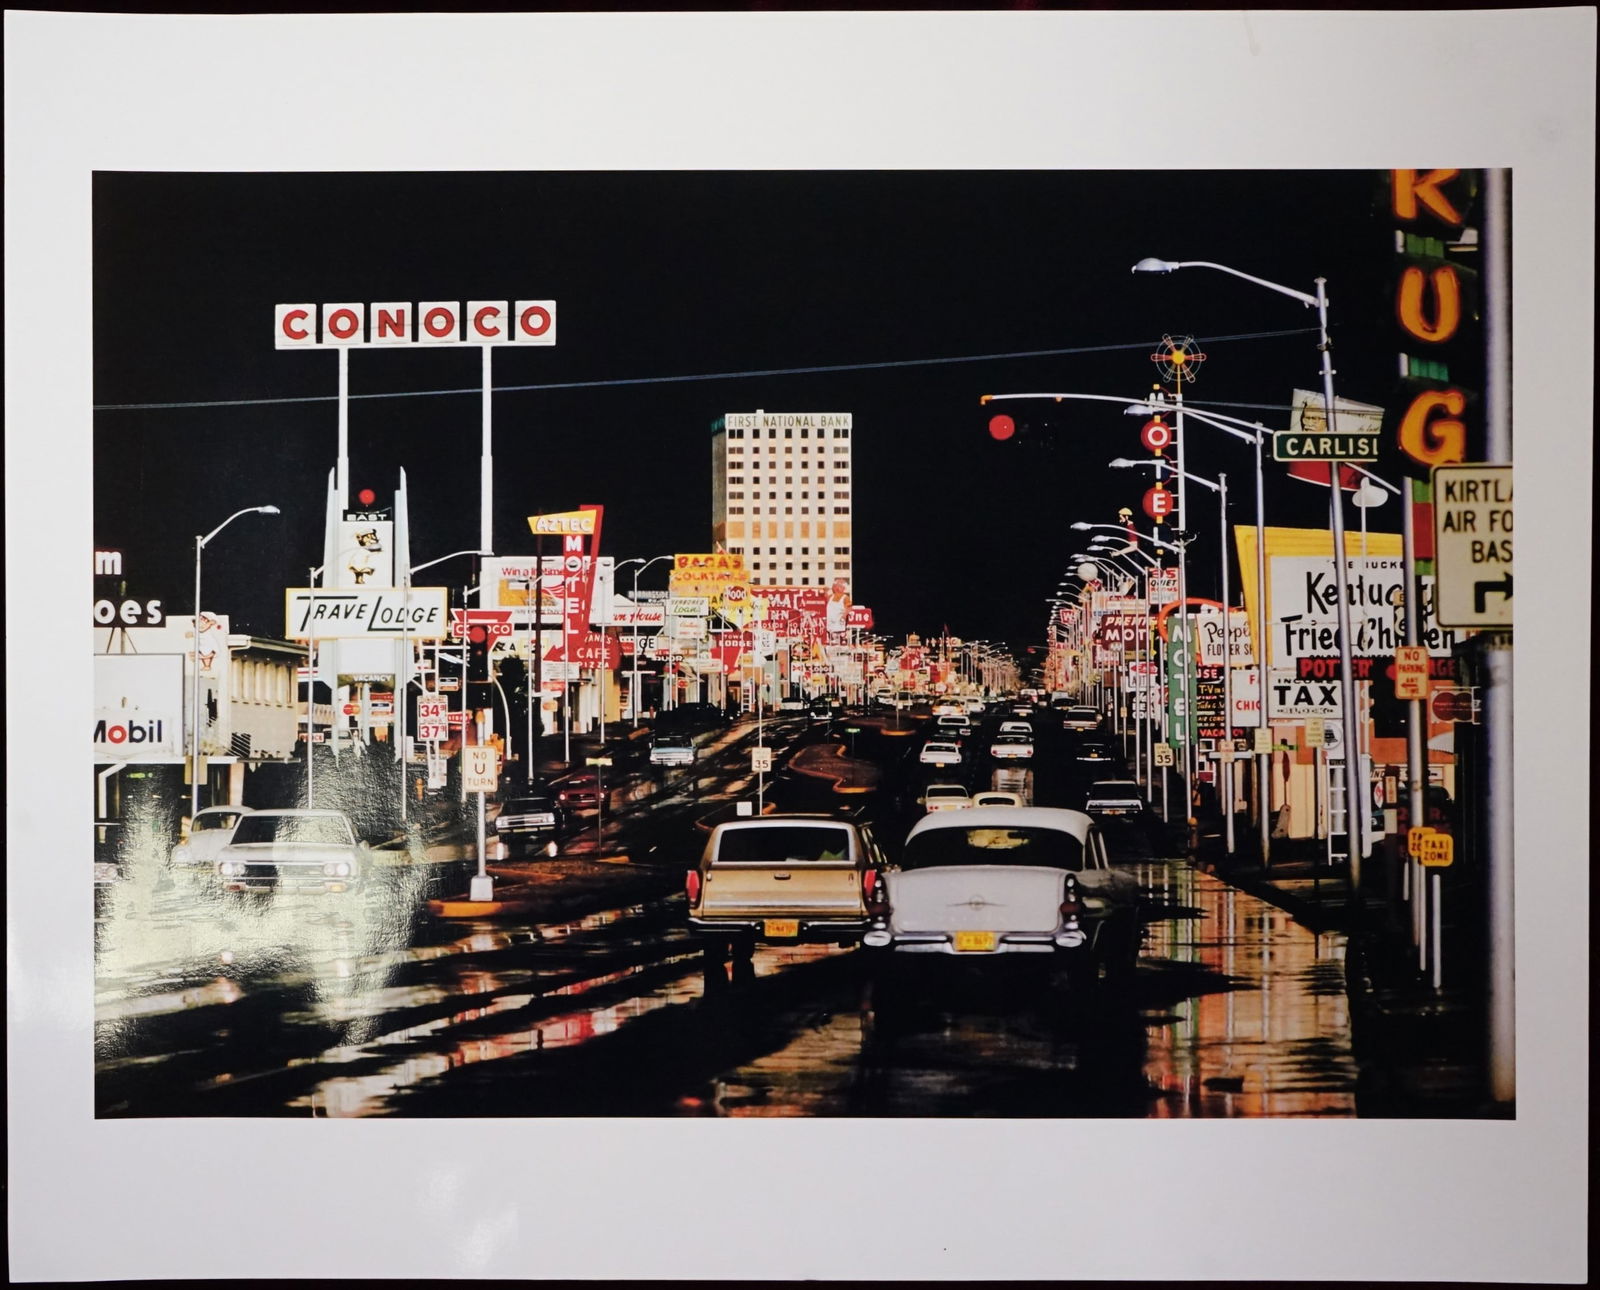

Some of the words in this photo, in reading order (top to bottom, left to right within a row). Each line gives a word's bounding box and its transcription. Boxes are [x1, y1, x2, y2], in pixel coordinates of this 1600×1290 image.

[282, 305, 552, 340] CONOCO
[728, 415, 758, 427] FIRST
[762, 415, 816, 427] NATIONAL
[820, 415, 849, 427] BANK
[1445, 479, 1513, 503] KIRTL
[346, 513, 388, 521] EAST
[1442, 509, 1477, 533] AIR
[536, 516, 593, 532] AZTEC
[1471, 540, 1513, 564] BAS
[502, 567, 522, 576] Win
[566, 535, 582, 634] MOTEL
[93, 599, 163, 625] oes
[576, 647, 612, 660] CAFE
[1403, 650, 1420, 662] NO
[1398, 664, 1425, 673] PARKING
[1172, 625, 1192, 739] MOTEL
[1273, 685, 1338, 706] TAX
[1199, 728, 1244, 737] VACACY
[472, 752, 487, 760] NO
[1156, 754, 1172, 764] 35
[474, 763, 486, 775] U
[755, 759, 769, 769] 35
[467, 777, 494, 786] TURN
[1424, 840, 1449, 849] TAXI
[1423, 852, 1449, 861] ZONE
